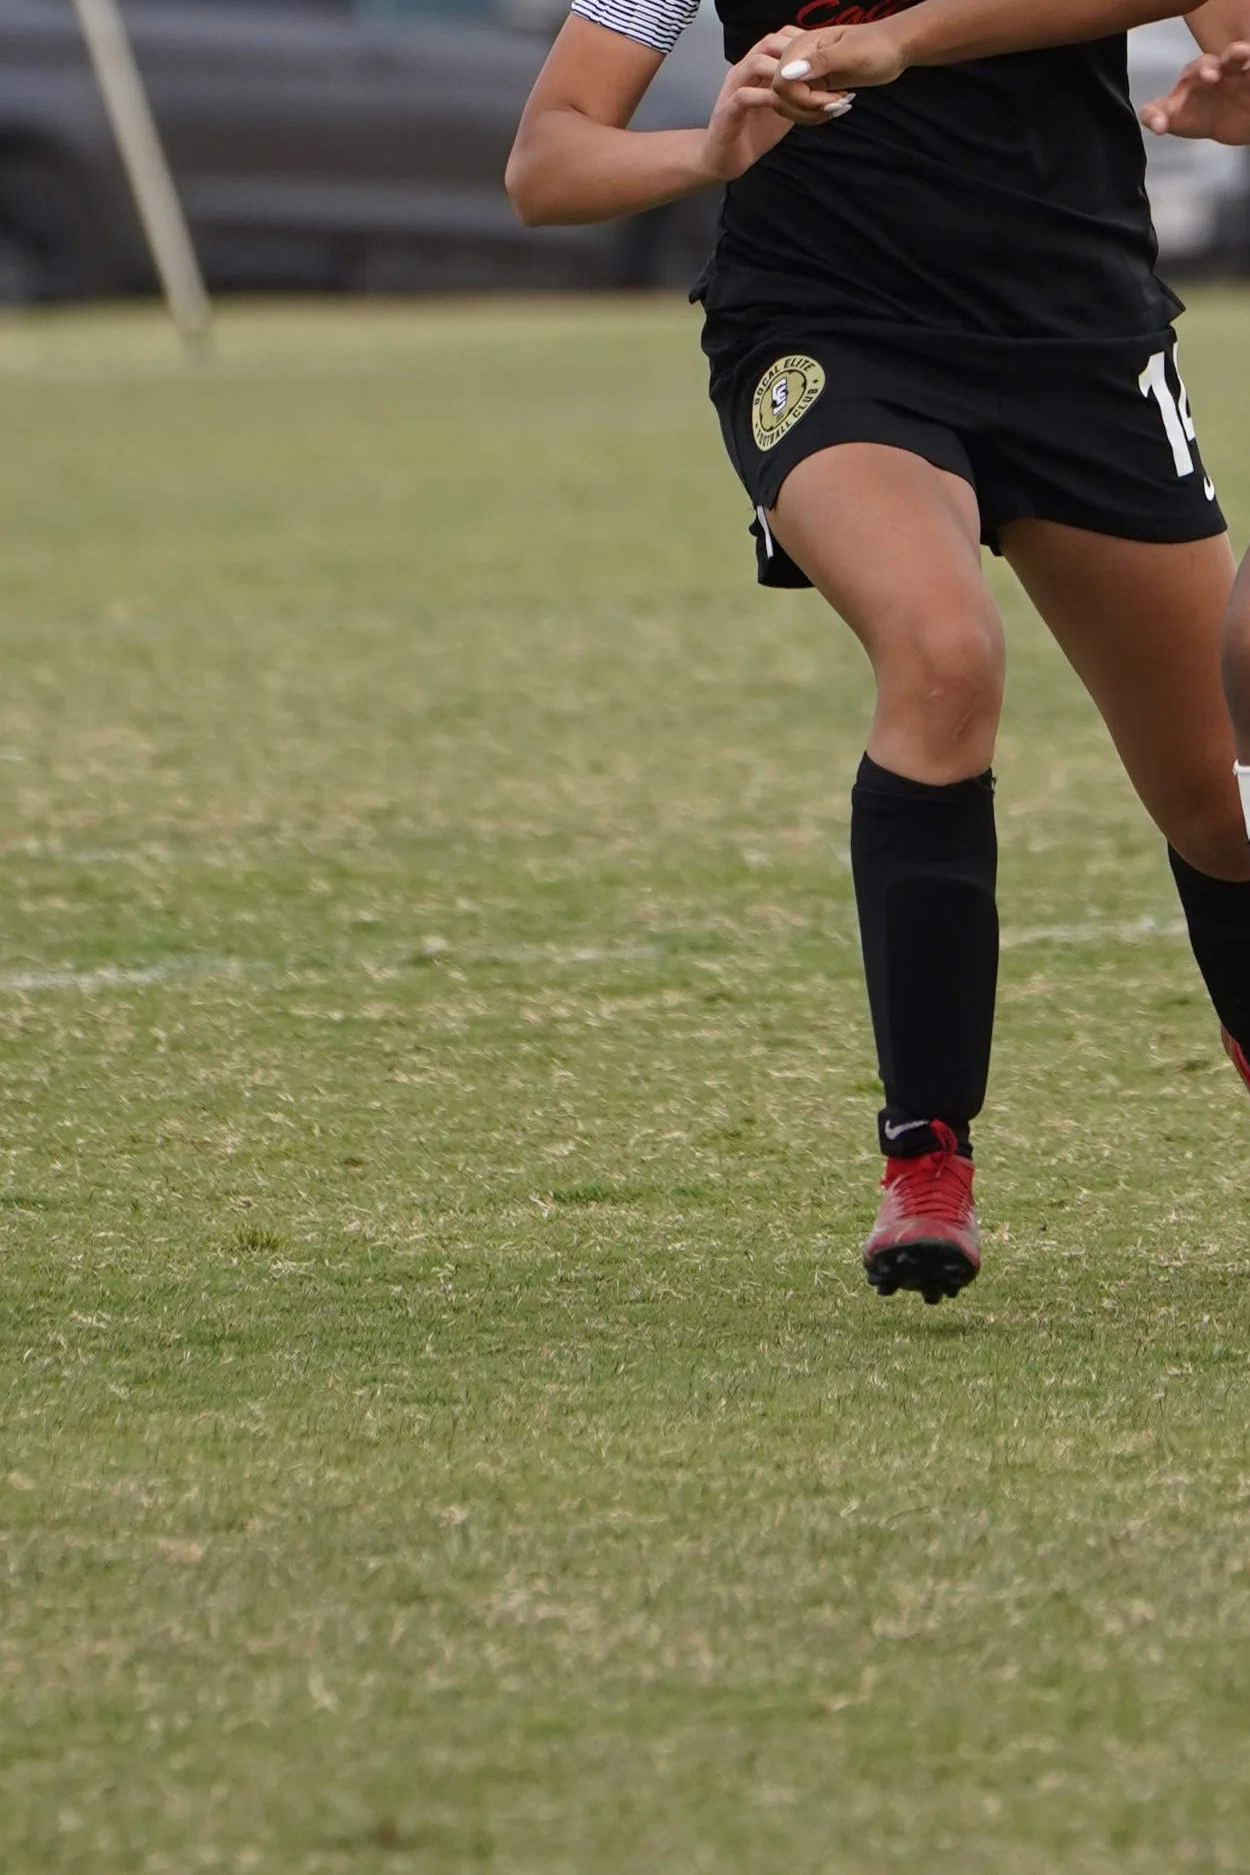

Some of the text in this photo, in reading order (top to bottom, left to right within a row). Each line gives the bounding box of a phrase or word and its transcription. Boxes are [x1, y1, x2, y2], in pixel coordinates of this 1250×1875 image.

[755, 357, 816, 406] SOCAL ELITE
[756, 388, 819, 447] FOOTBALL CLUB
